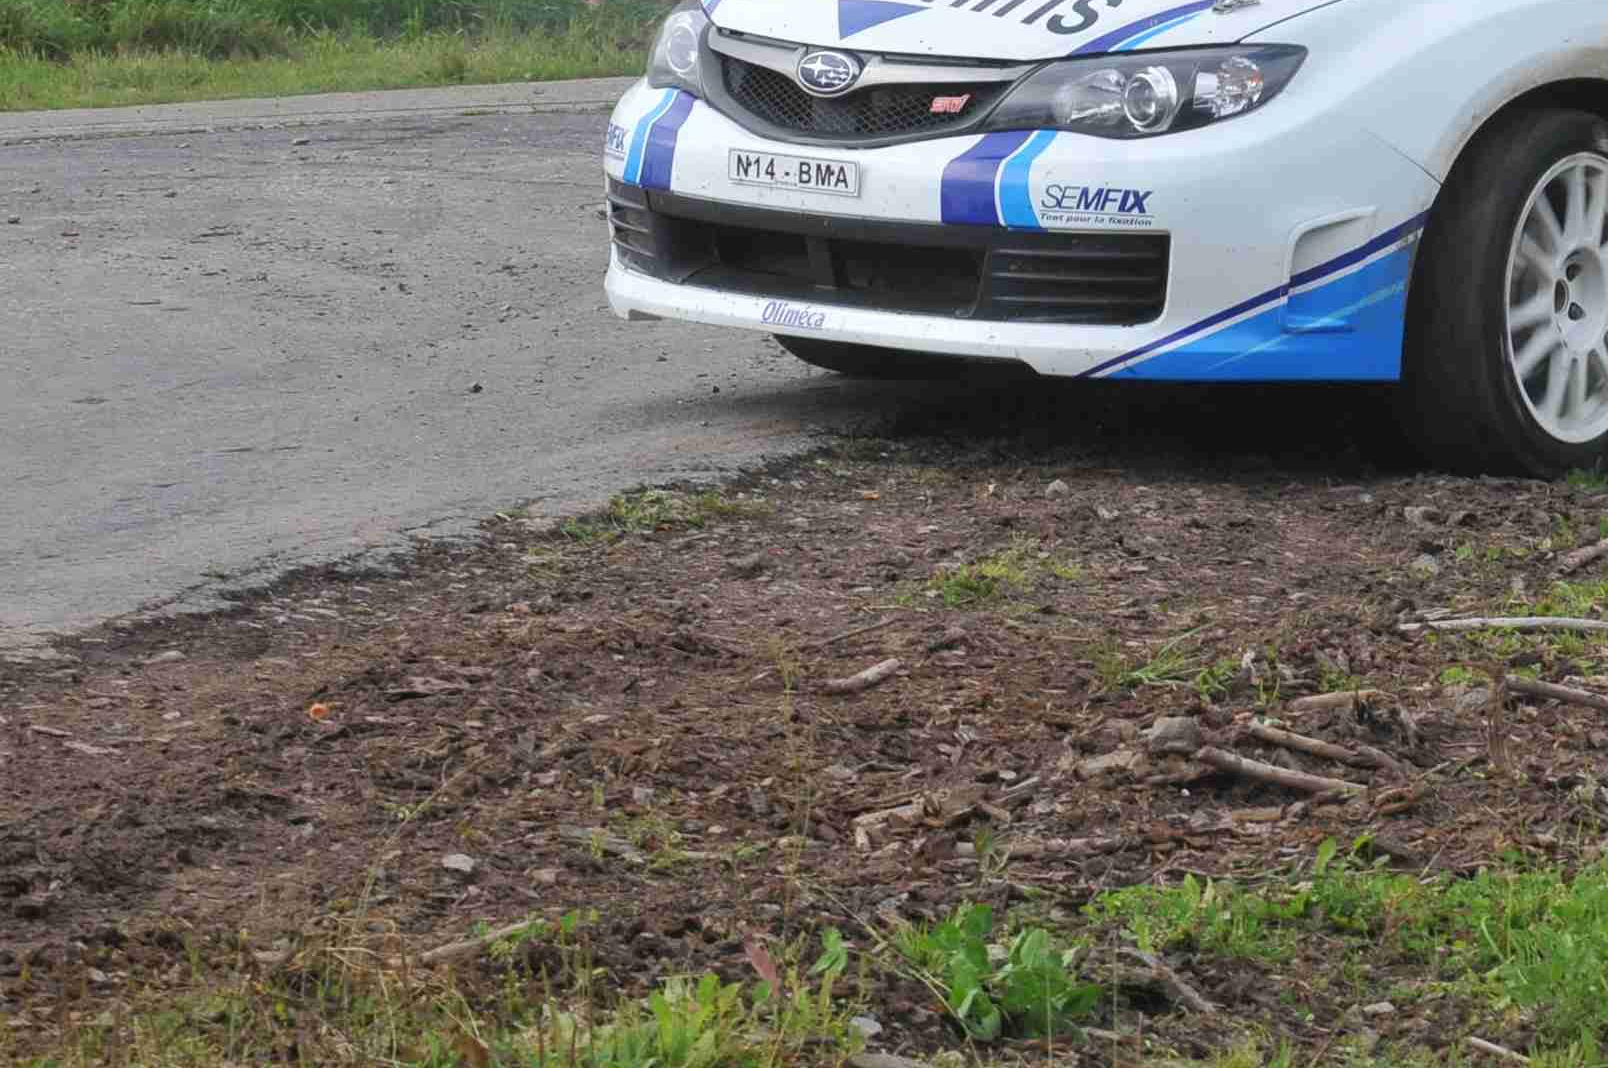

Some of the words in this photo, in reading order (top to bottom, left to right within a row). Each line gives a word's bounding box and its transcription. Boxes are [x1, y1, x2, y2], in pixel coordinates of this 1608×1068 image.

[1041, 184, 1154, 214] SEMFIX
[1040, 213, 1063, 222] Tout
[1066, 214, 1089, 223] pour
[1095, 215, 1104, 223] la
[1109, 216, 1152, 227] fixation
[761, 300, 826, 327] Oliméca
